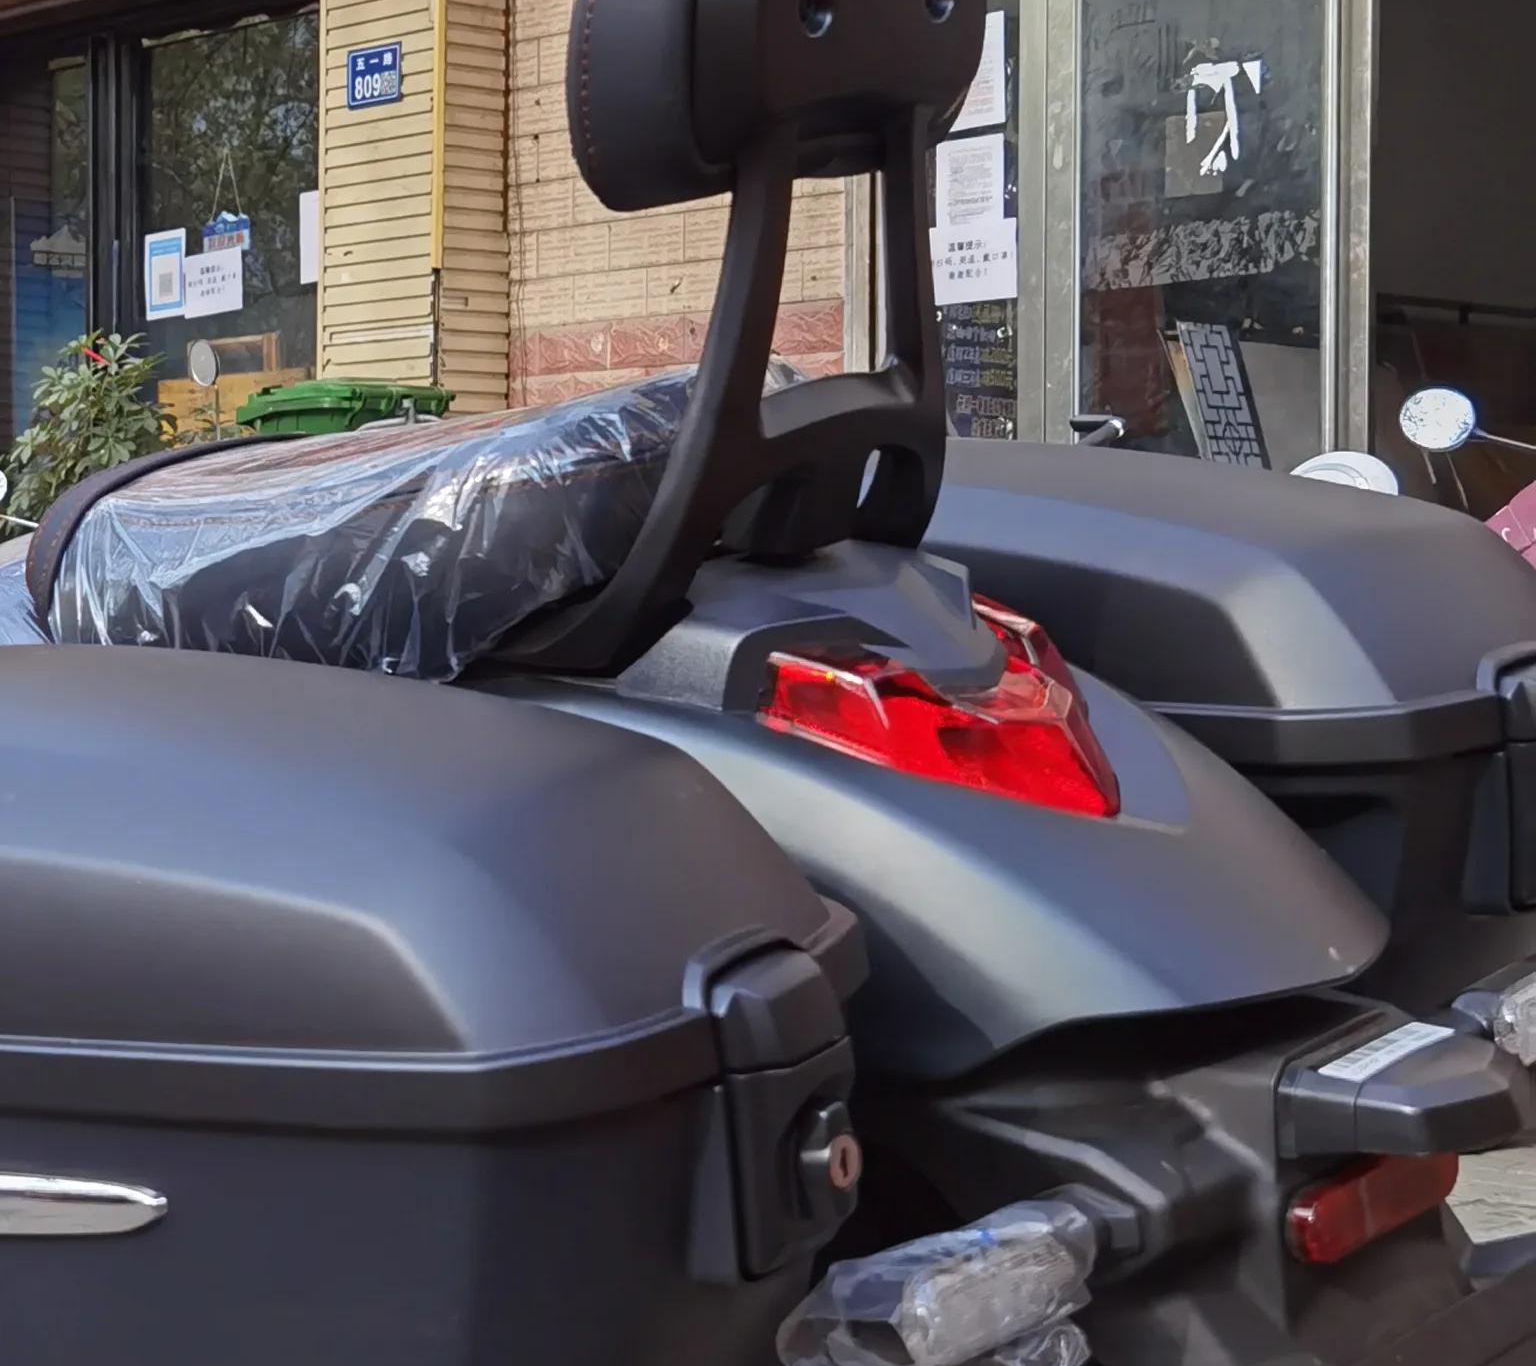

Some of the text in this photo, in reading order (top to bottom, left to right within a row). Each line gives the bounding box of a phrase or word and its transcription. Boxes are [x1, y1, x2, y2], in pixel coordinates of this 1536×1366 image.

[355, 51, 393, 71] 五一路
[354, 73, 381, 100] 809
